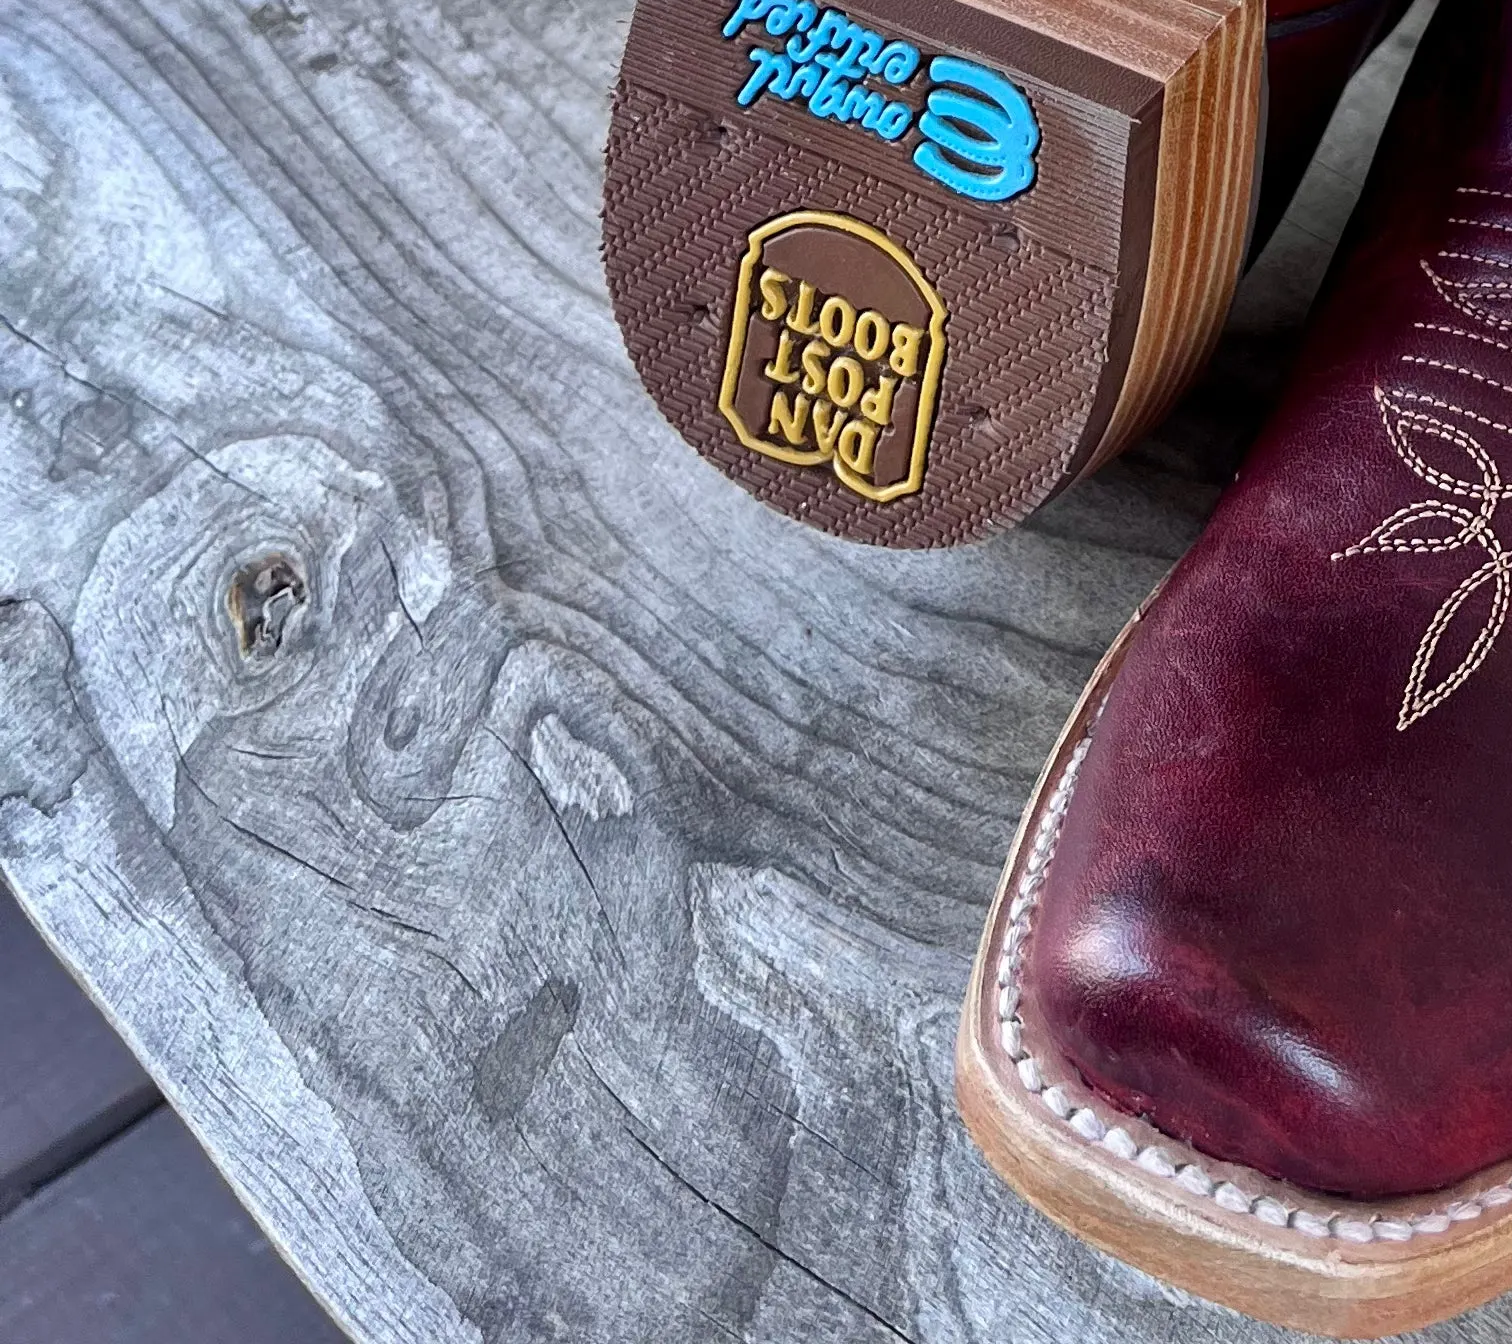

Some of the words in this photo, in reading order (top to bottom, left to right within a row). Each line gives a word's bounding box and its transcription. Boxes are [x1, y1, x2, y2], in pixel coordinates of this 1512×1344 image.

[737, 47, 1037, 202] Cowgirl
[759, 267, 922, 378] BOOTS
[765, 329, 895, 426] POST
[770, 391, 877, 475] DAN
